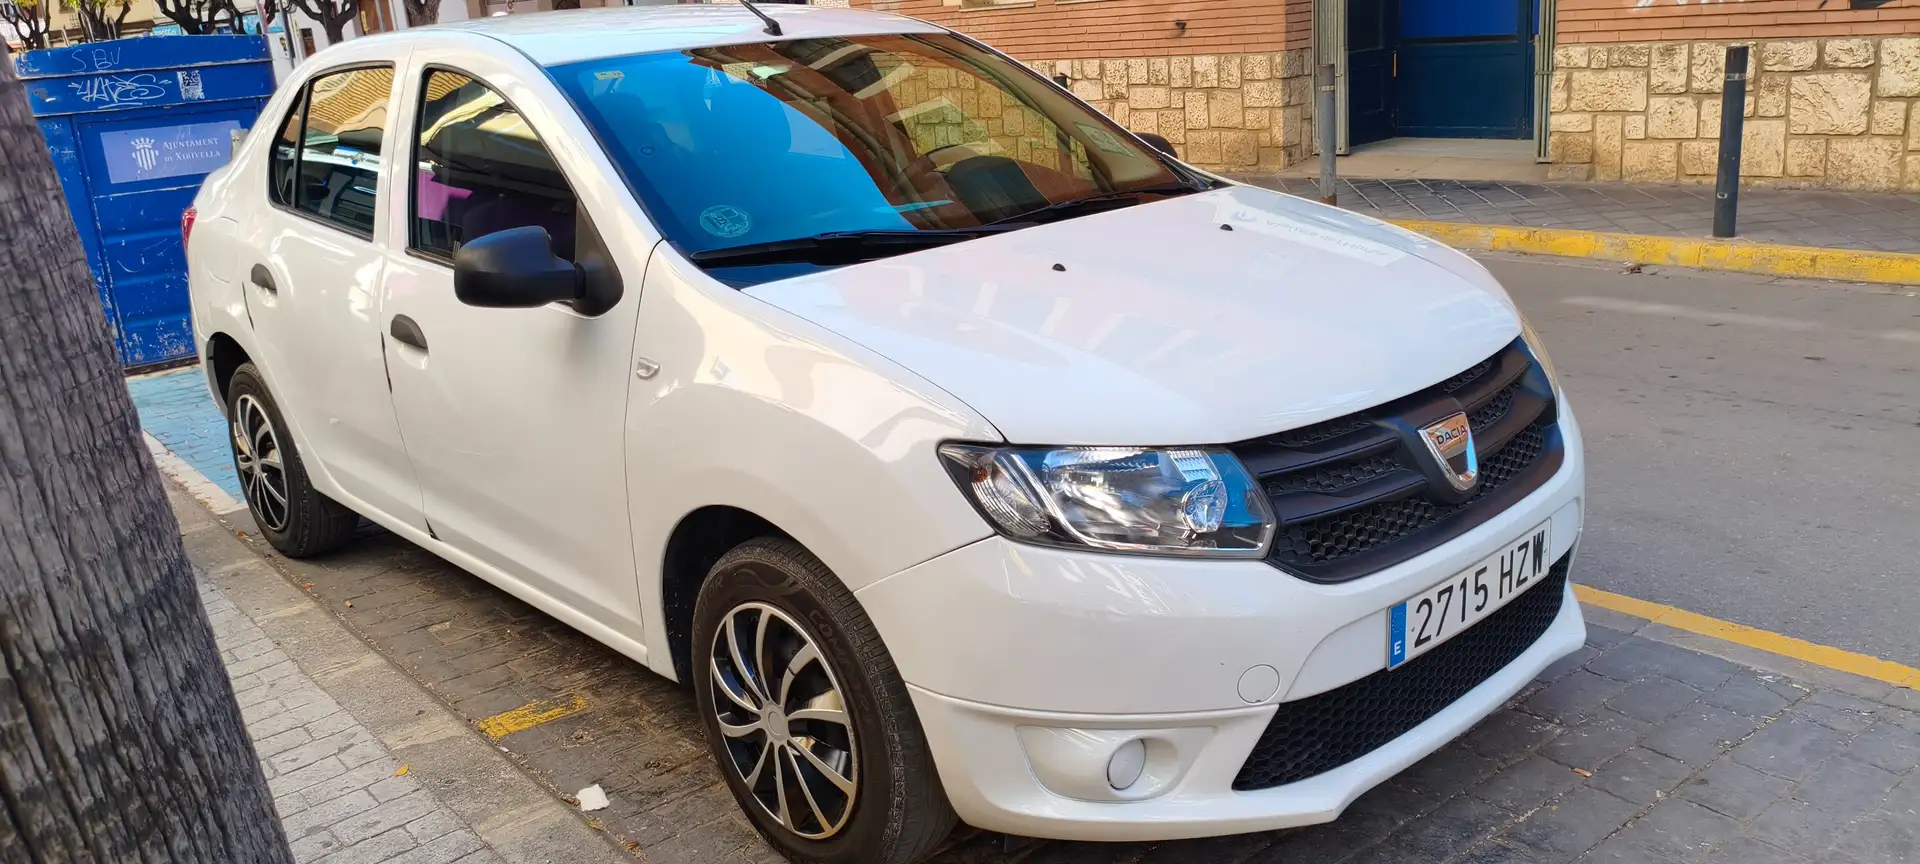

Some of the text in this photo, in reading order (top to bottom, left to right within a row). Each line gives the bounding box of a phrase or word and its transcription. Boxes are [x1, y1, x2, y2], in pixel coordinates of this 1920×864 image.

[163, 138, 218, 150] AJUNTAMENT
[175, 150, 220, 161] XIRIVELLA
[1436, 424, 1468, 446] DACIA
[1413, 529, 1546, 649] 2715 HZW
[1394, 641, 1402, 656] E
